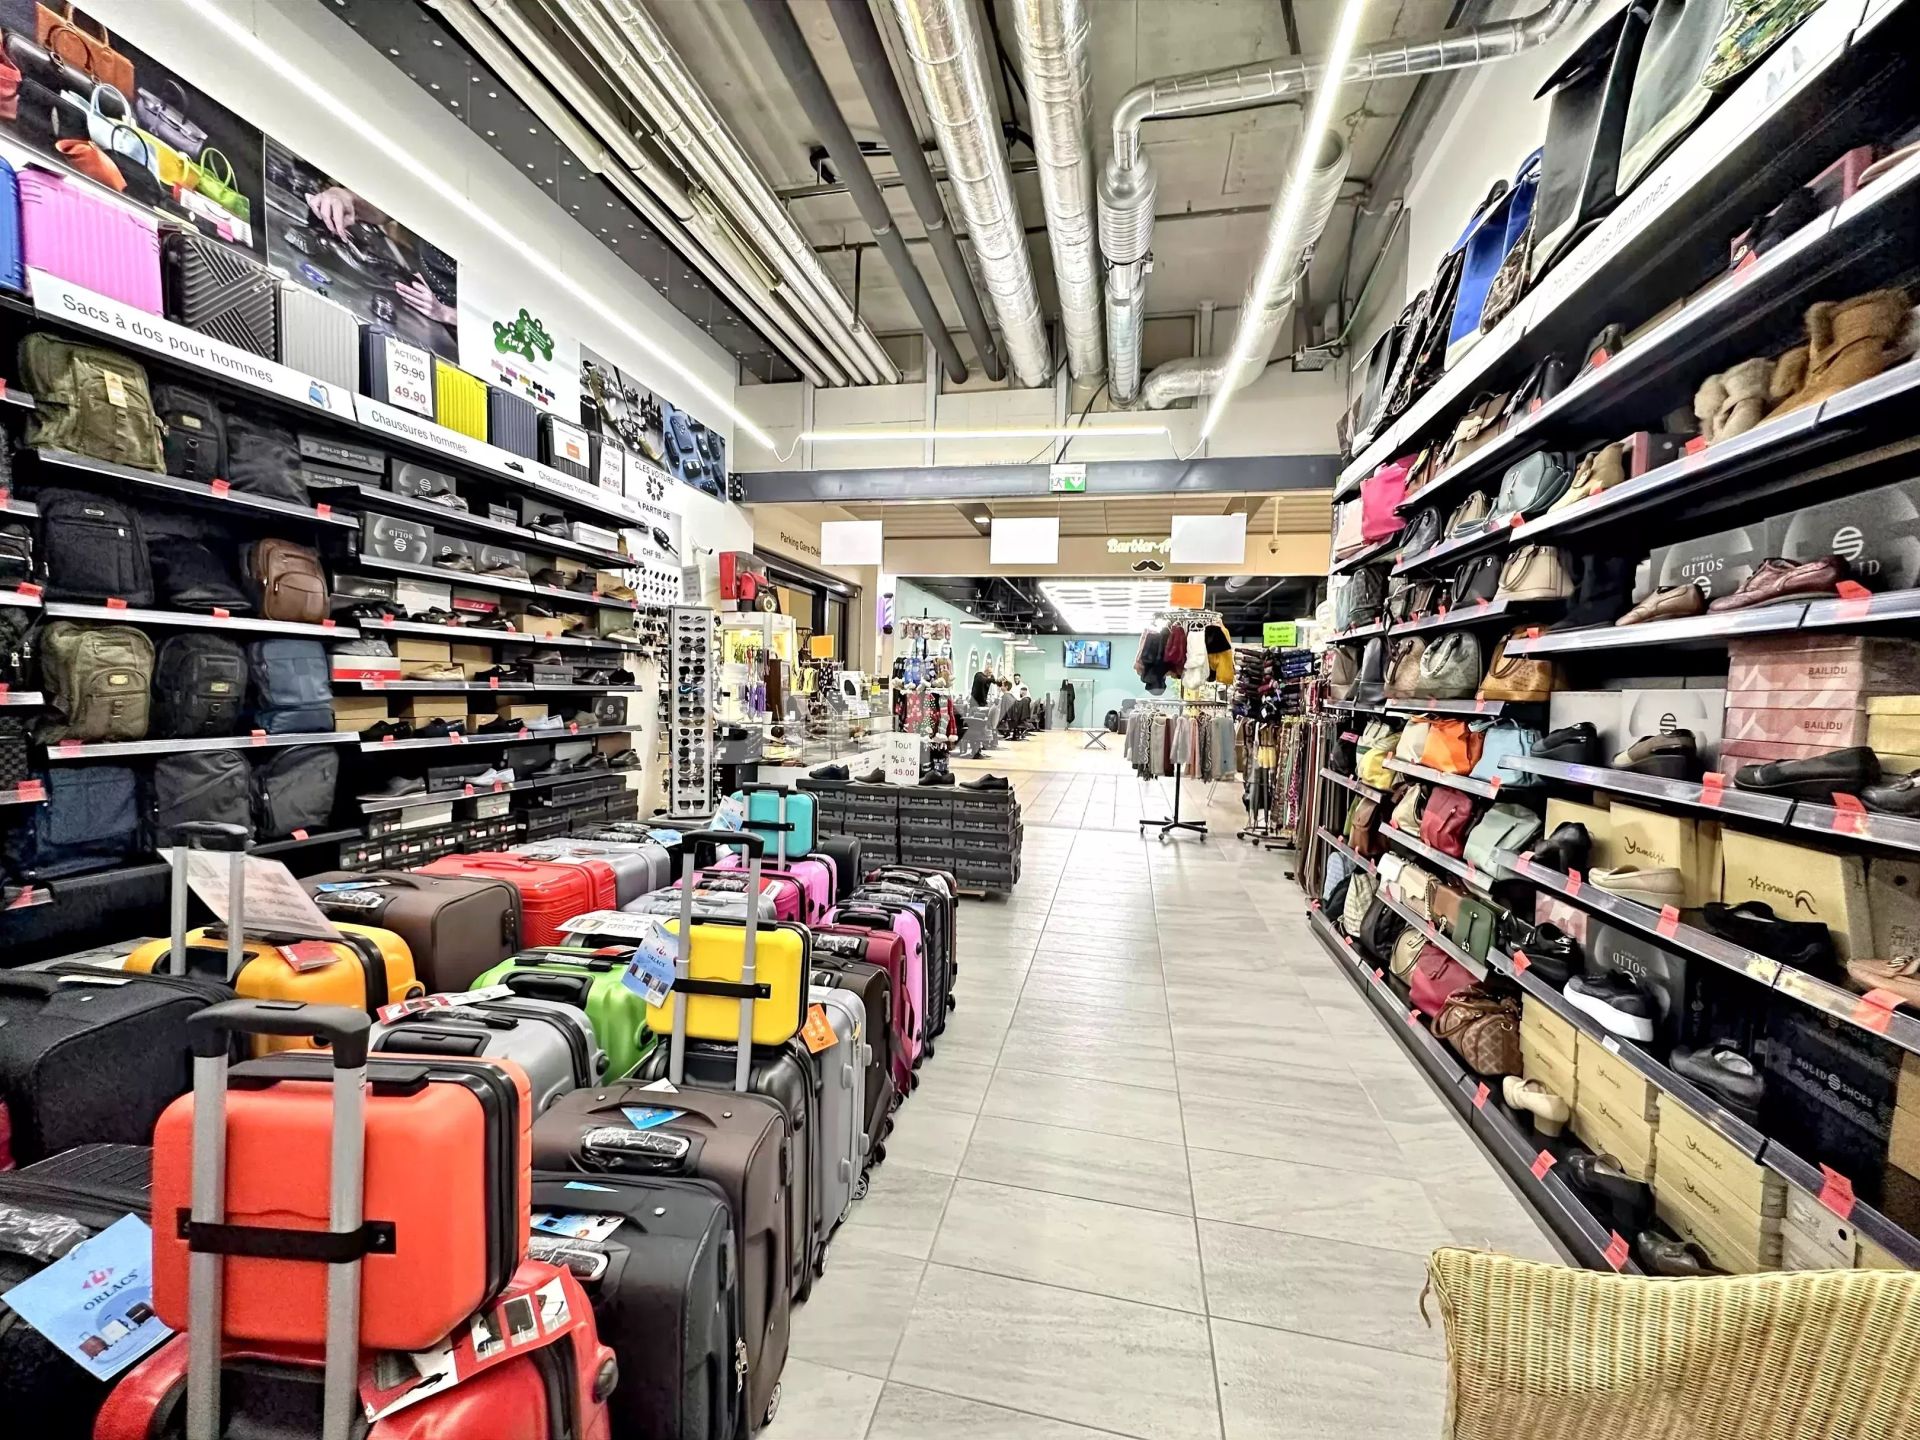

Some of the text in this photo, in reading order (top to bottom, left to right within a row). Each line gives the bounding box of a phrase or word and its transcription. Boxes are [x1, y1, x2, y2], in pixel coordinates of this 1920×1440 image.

[62, 293, 274, 384] Sacs à dos pour hommes
[394, 348, 424, 365] ACTION
[393, 360, 426, 381] 79.90
[394, 385, 427, 405] 49.90
[371, 410, 468, 455] Chaussures hommes
[538, 470, 574, 492] Chaussures
[651, 466, 675, 486] VOITURE
[642, 502, 671, 520] PARTIR DE
[388, 529, 413, 540] SOLID
[780, 531, 799, 551] Parking
[642, 547, 654, 558] CHF
[1681, 557, 1725, 578] SOLID
[1807, 665, 1848, 676] BAILIDU
[1803, 720, 1843, 731] BAILIDU
[894, 740, 912, 750] Tout
[1612, 952, 1648, 978] SOLID
[1796, 1056, 1873, 1108] SOLID SHOES
[83, 1272, 139, 1311] ORLACS
